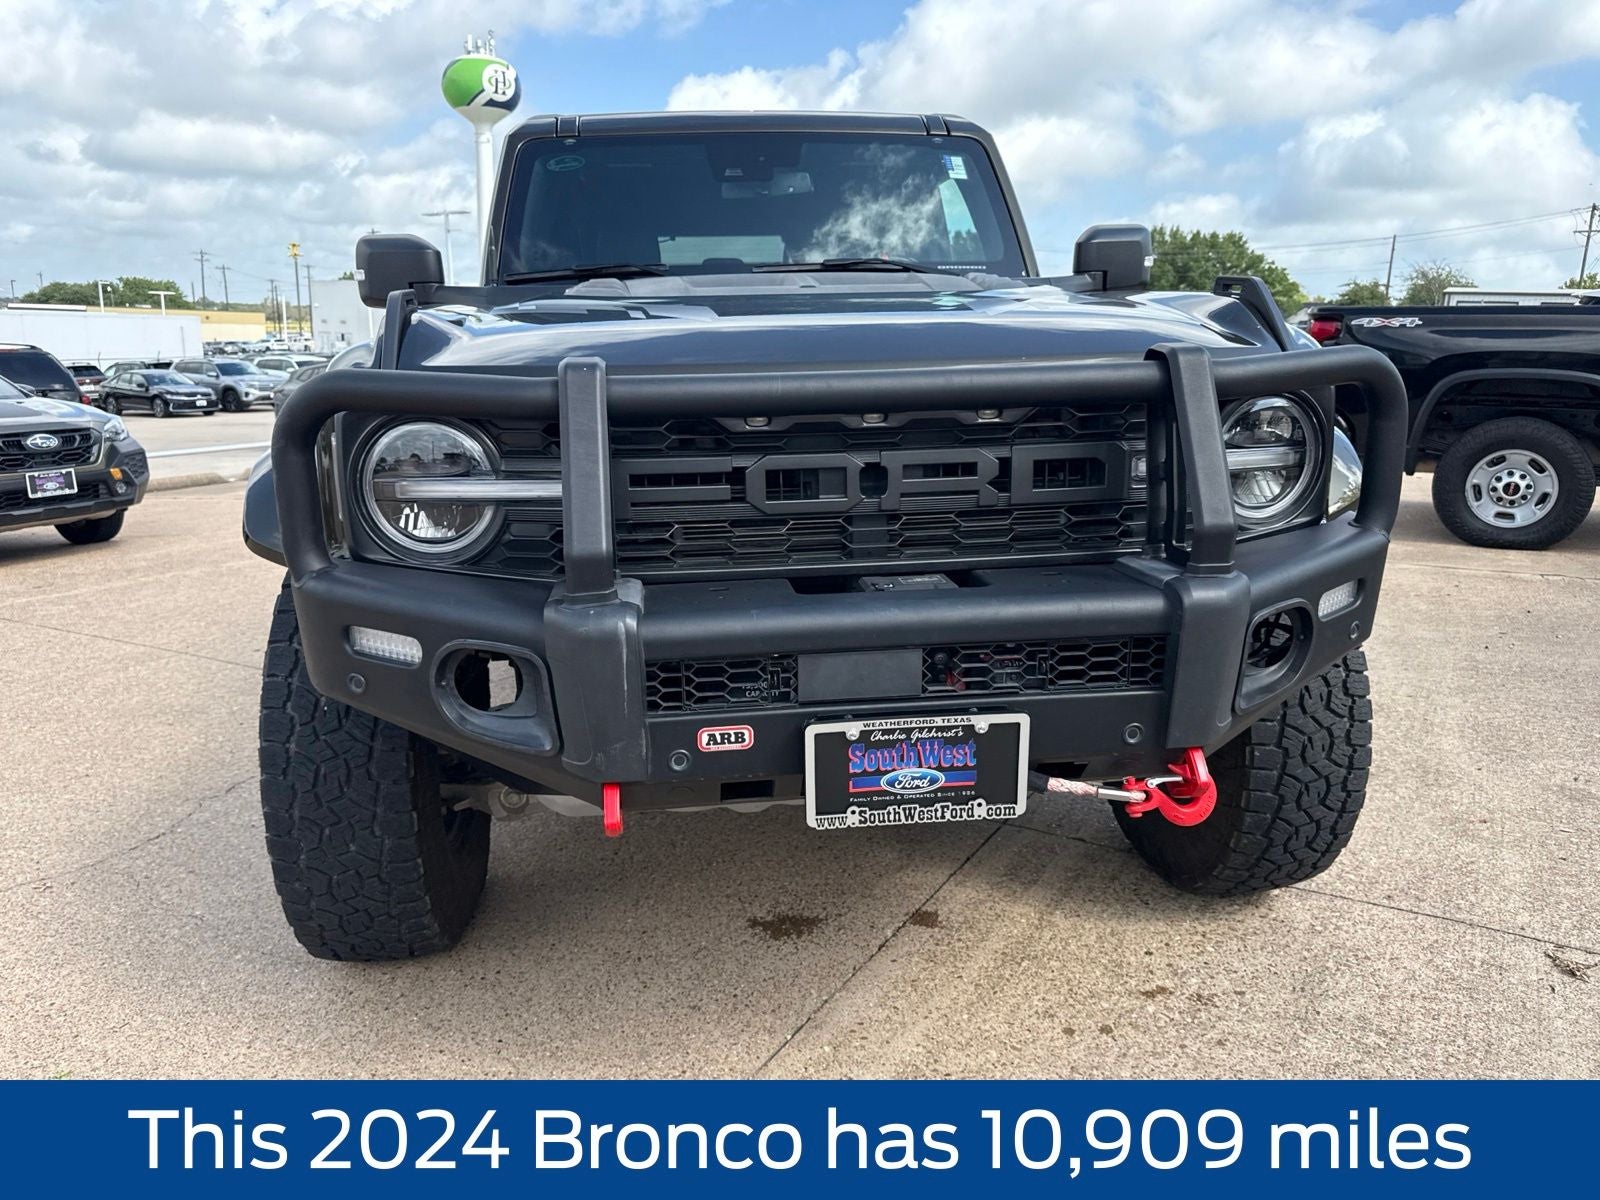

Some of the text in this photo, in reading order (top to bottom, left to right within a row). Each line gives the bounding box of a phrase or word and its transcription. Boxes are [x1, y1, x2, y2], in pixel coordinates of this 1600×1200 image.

[610, 441, 1131, 520] FORD
[705, 731, 747, 746] ARB
[870, 727, 964, 743] Charlie Gilchrist's
[894, 771, 931, 789] Ford
